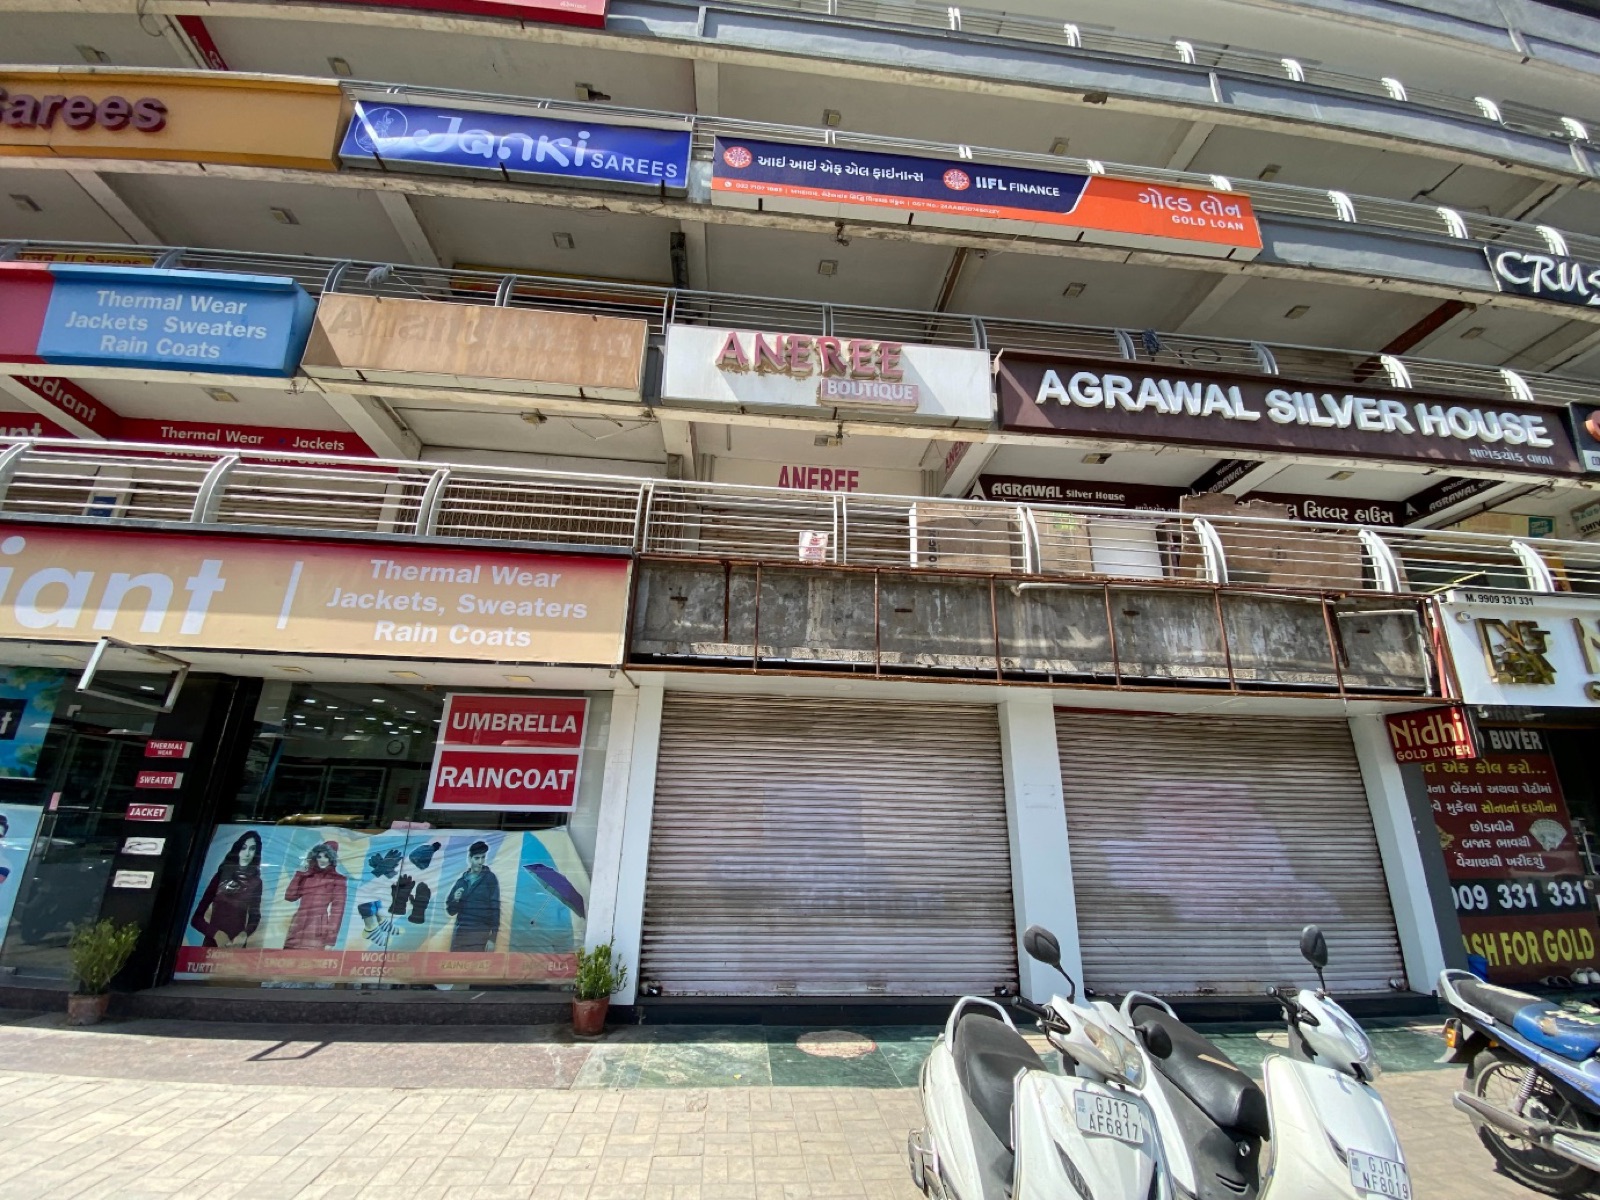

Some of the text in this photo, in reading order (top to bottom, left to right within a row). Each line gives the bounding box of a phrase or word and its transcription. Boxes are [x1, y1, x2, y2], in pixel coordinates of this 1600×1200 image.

[590, 153, 678, 178] SAREES
[975, 176, 1060, 196] IIFL FINANCE
[1138, 188, 1242, 218] ગોલ્ડ લોન
[1172, 215, 1244, 231] GOLD LOAN
[97, 290, 247, 315] Thermal Wear
[65, 311, 267, 339] Jackets Sweaters
[100, 335, 220, 358] Rain Coats
[715, 332, 904, 380] ANEREE
[827, 378, 914, 400] BOUTIQUE
[1035, 369, 1554, 448] AGRAWAL SILVER HOUSE
[160, 426, 345, 451] Thermal Wear Jackets
[991, 482, 1125, 502] AGRAWAL Silver House
[1303, 500, 1349, 521] સિલ્વર
[370, 559, 561, 588] Thermal Wear
[326, 588, 588, 619] Jackets, Sweaters
[1465, 593, 1534, 606] M. 9909 331 331
[373, 620, 532, 647] Rain Coats
[452, 712, 577, 733] UMBRELLA
[1388, 712, 1465, 749] Nidhi
[150, 742, 183, 750] THERMAL
[1489, 729, 1543, 750] BUYER
[1396, 744, 1471, 761] GOLD BUYER
[1443, 760, 1469, 773] એક
[1476, 758, 1505, 774] કોલ
[139, 776, 174, 785] SWEATER
[438, 766, 574, 790] RAINCOAT
[1487, 784, 1518, 794] અથવા
[129, 806, 165, 817] JACKET
[1469, 820, 1515, 832] છોડાવીને
[1496, 836, 1531, 848] ભાવથી
[1497, 883, 1538, 909] 331
[1547, 880, 1586, 907] 331
[1500, 930, 1542, 965] FOR
[1542, 927, 1595, 962] GOLD
[1096, 1097, 1129, 1119] GJ13
[1089, 1113, 1138, 1140] AF6817
[1368, 1157, 1398, 1179] GJ01
[1362, 1171, 1409, 1199] NF8019
